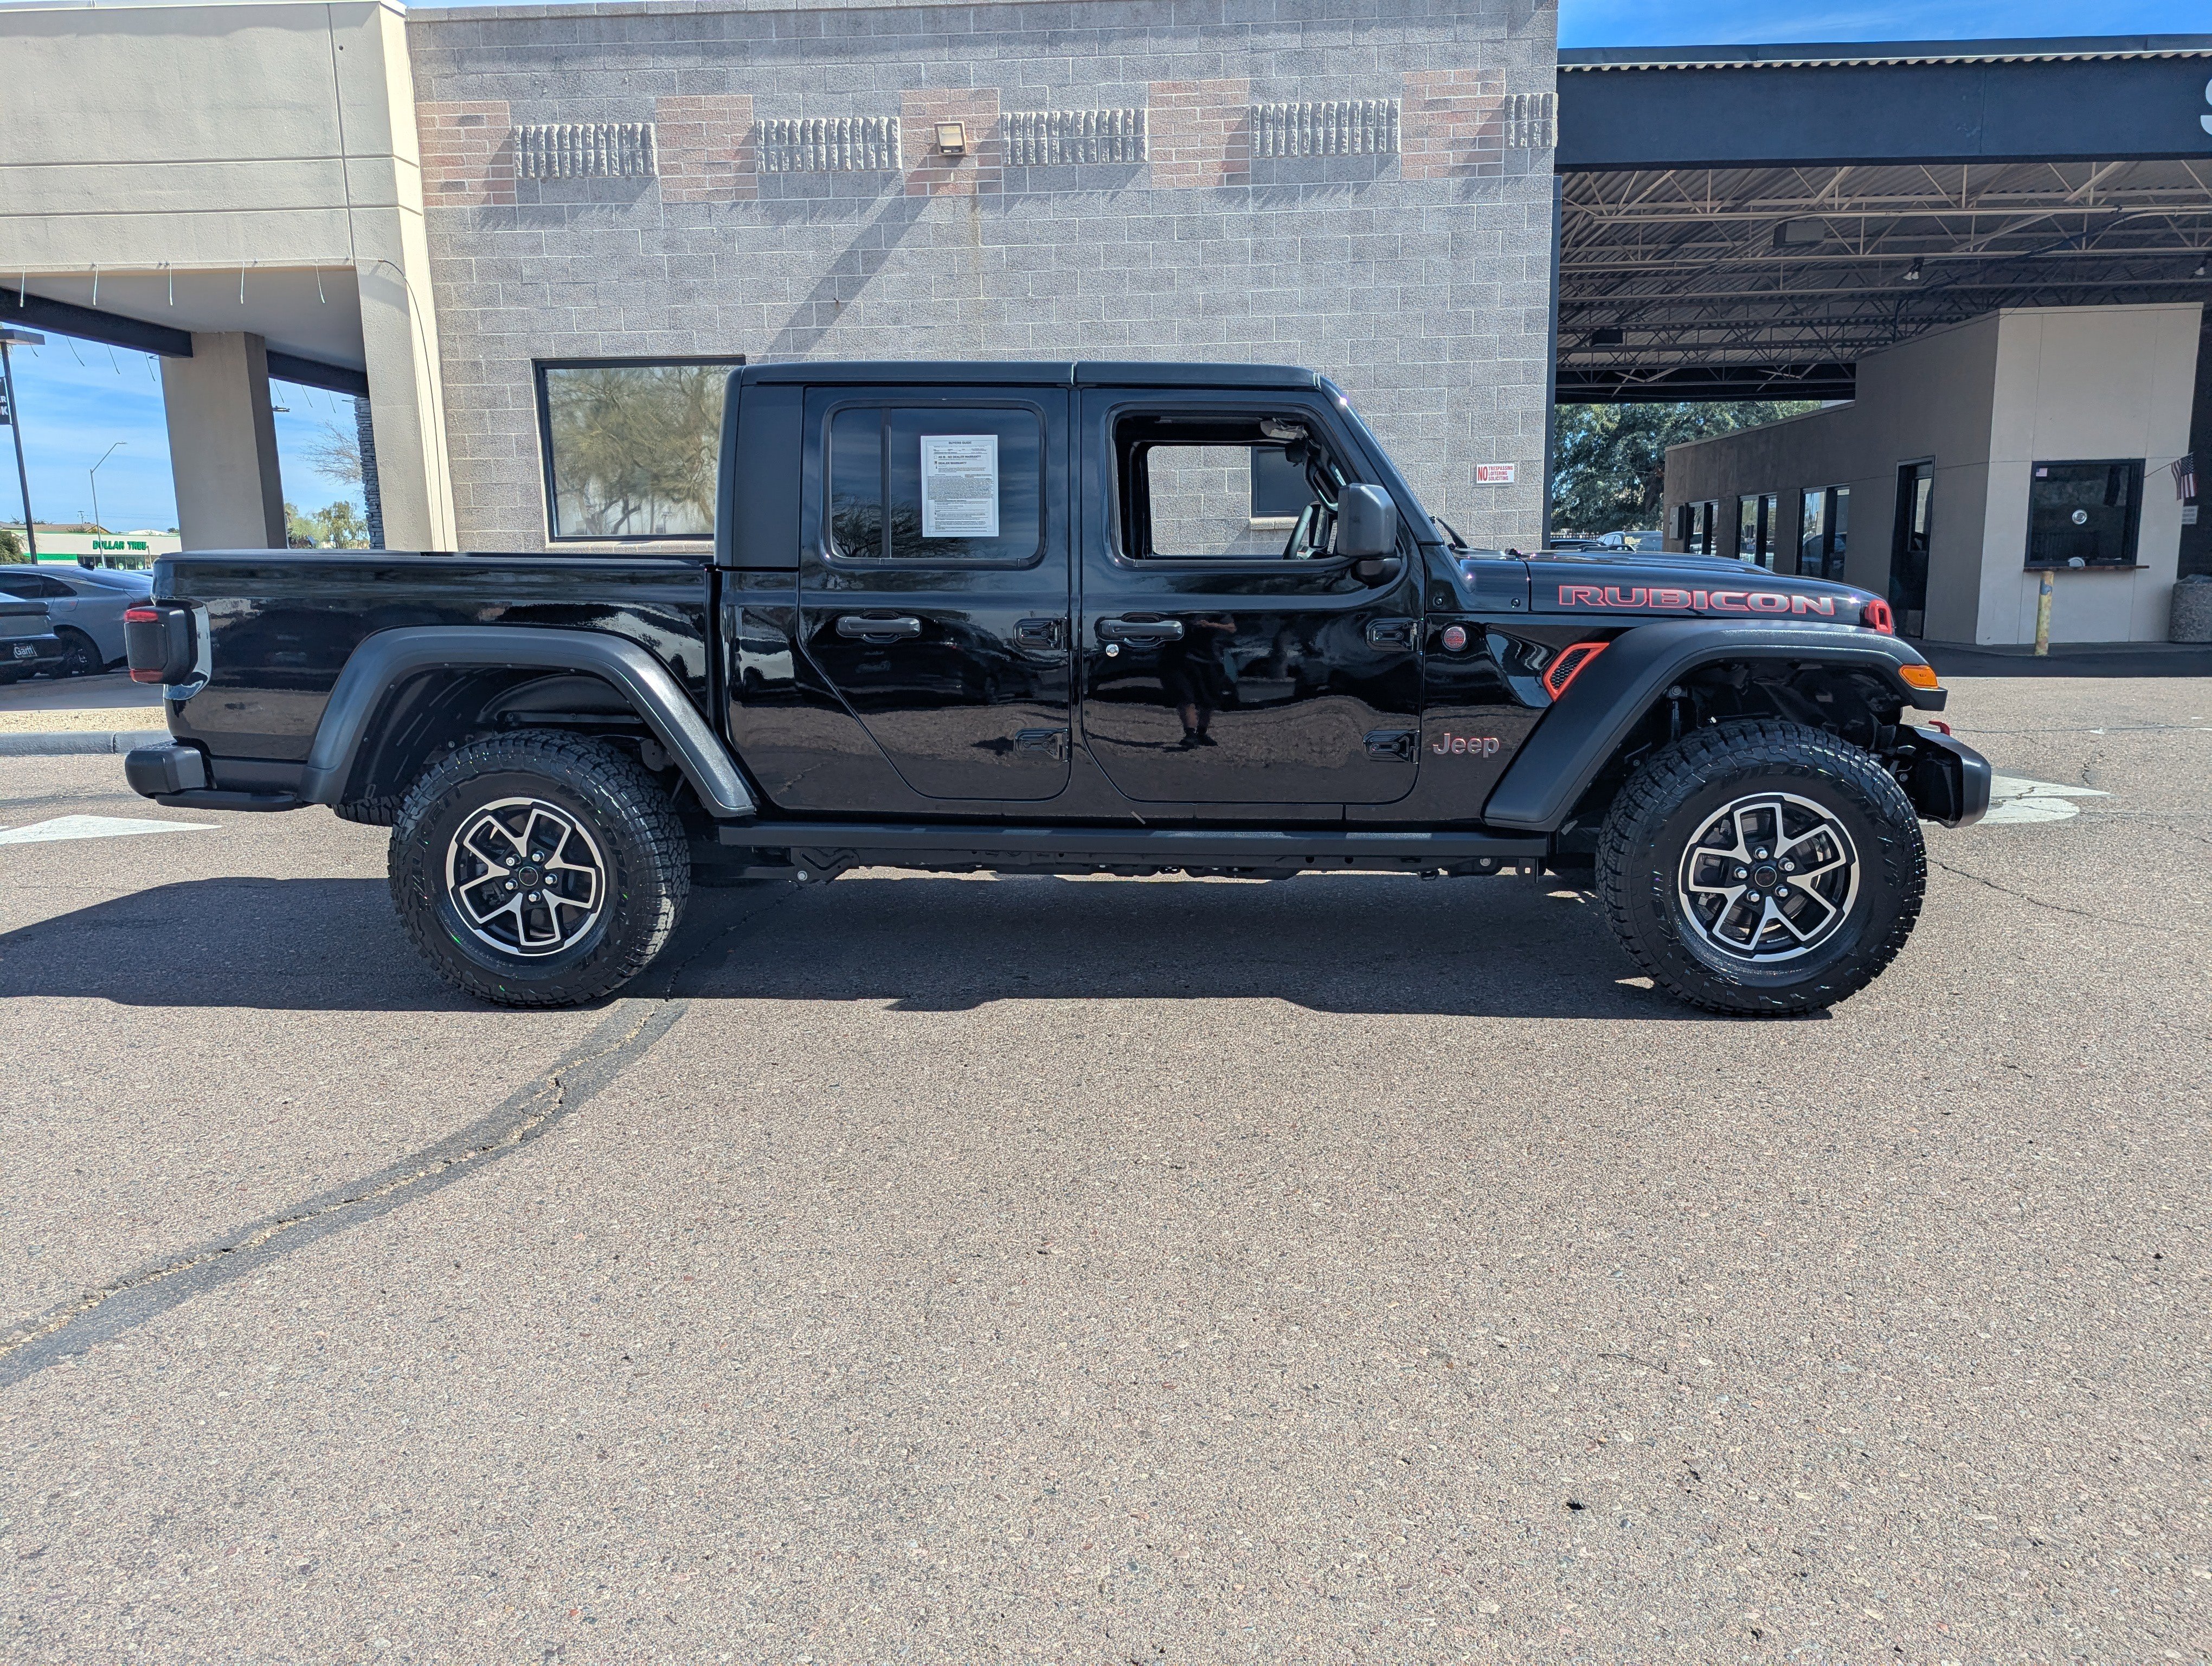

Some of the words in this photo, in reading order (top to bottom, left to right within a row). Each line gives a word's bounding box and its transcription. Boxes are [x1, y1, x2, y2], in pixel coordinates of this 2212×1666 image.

[1478, 466, 1488, 481] NO
[127, 541, 147, 550] TREE
[1558, 585, 1836, 616] RUBICON
[1432, 733, 1500, 758] Jeep
